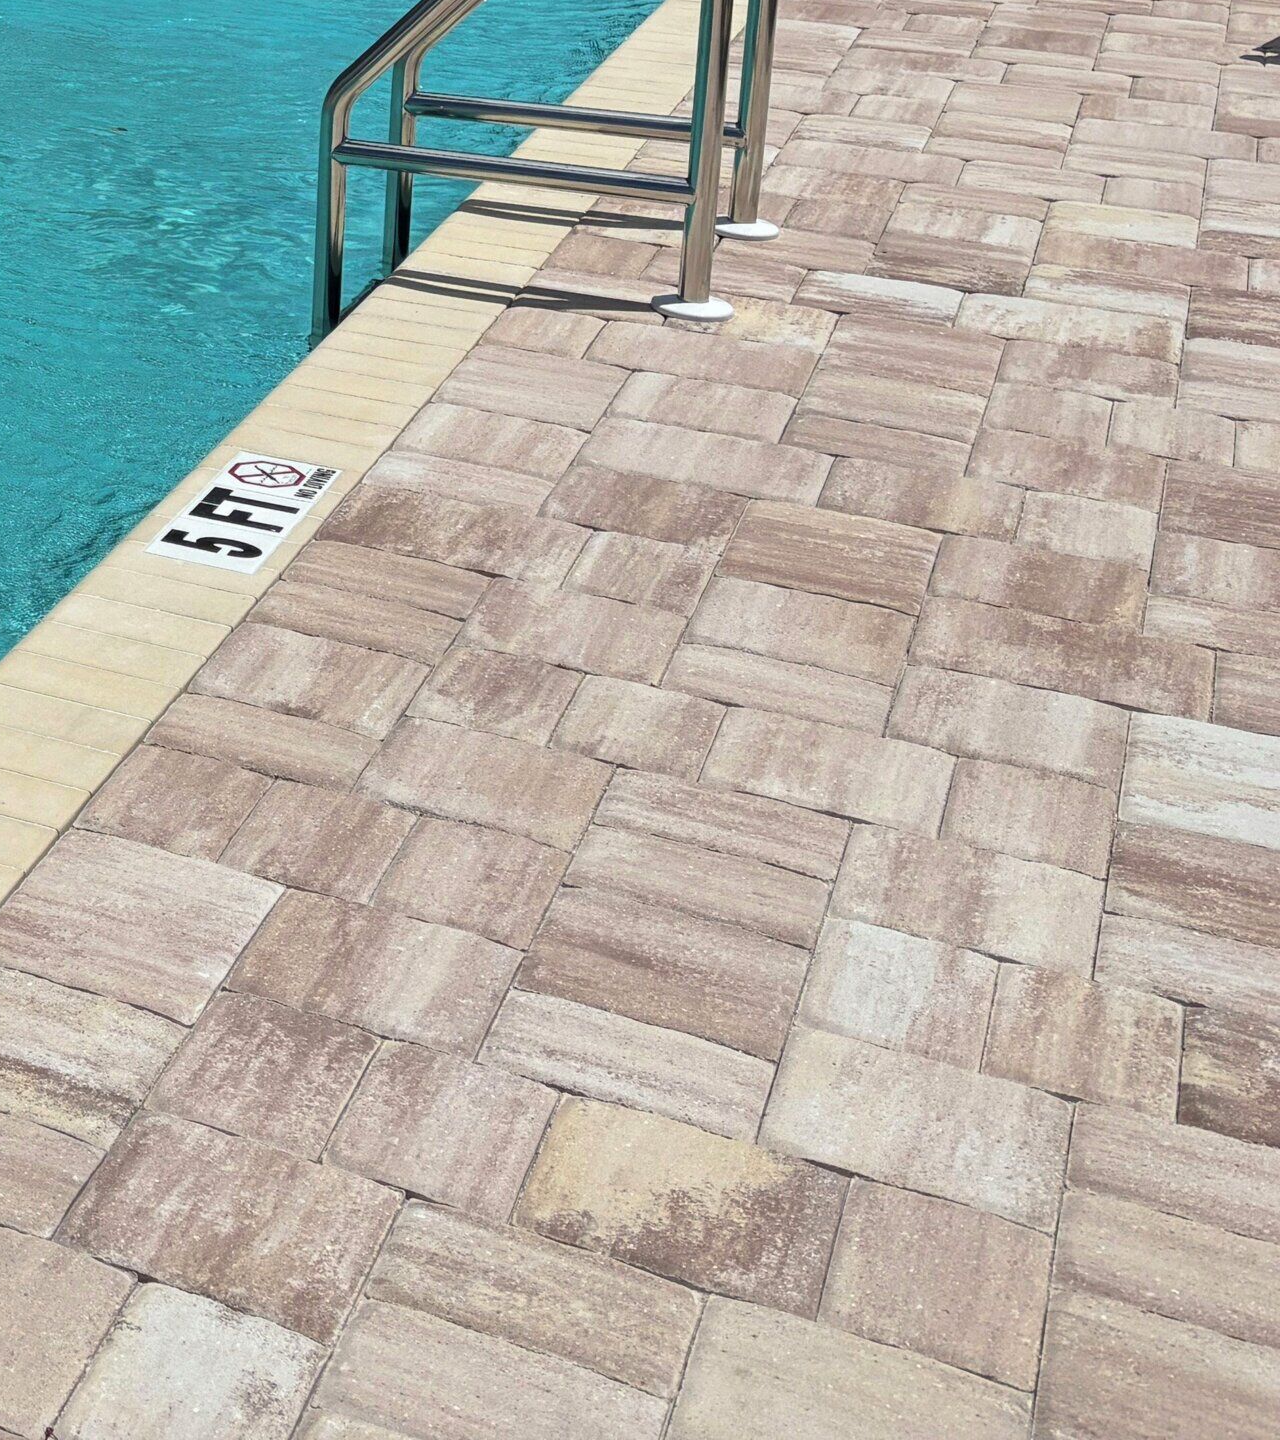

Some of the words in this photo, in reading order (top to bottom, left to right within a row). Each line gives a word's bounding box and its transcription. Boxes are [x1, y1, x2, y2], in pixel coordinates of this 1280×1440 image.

[303, 468, 337, 490] DIVING
[294, 489, 318, 500] NO
[188, 486, 300, 534] FT
[161, 528, 263, 558] 5
